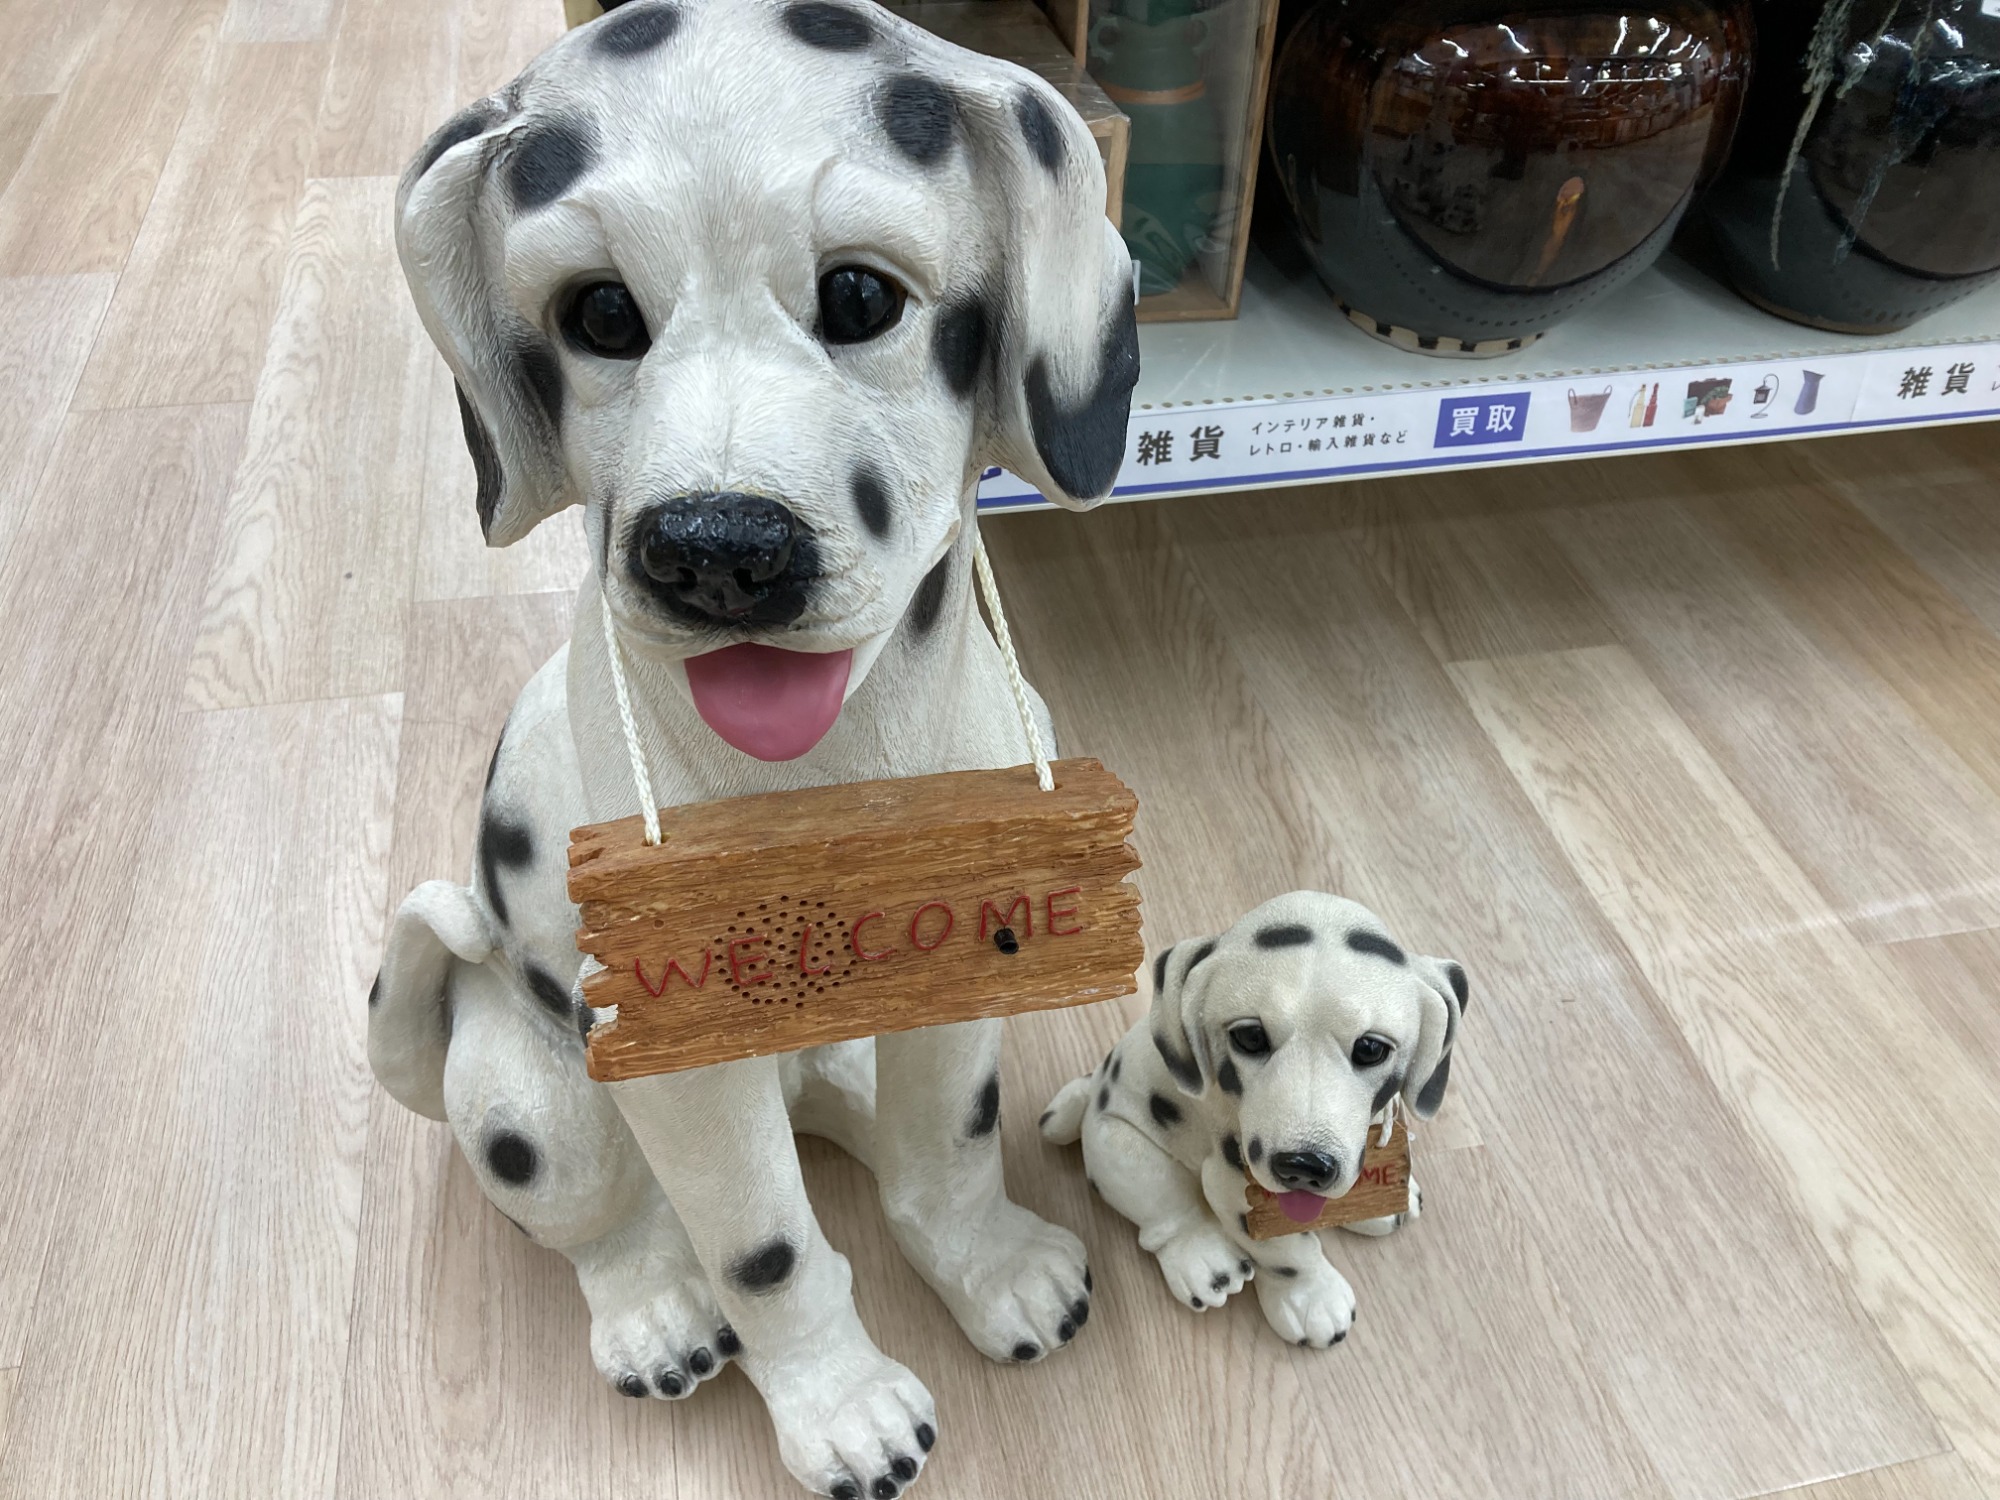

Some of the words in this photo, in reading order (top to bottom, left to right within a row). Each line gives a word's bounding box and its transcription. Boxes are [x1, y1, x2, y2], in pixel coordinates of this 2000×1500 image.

[1897, 362, 1975, 400] 雑貨
[1449, 404, 1516, 437] 買取
[1136, 425, 1225, 466] 雑貨
[634, 886, 1083, 998] WELCOME
